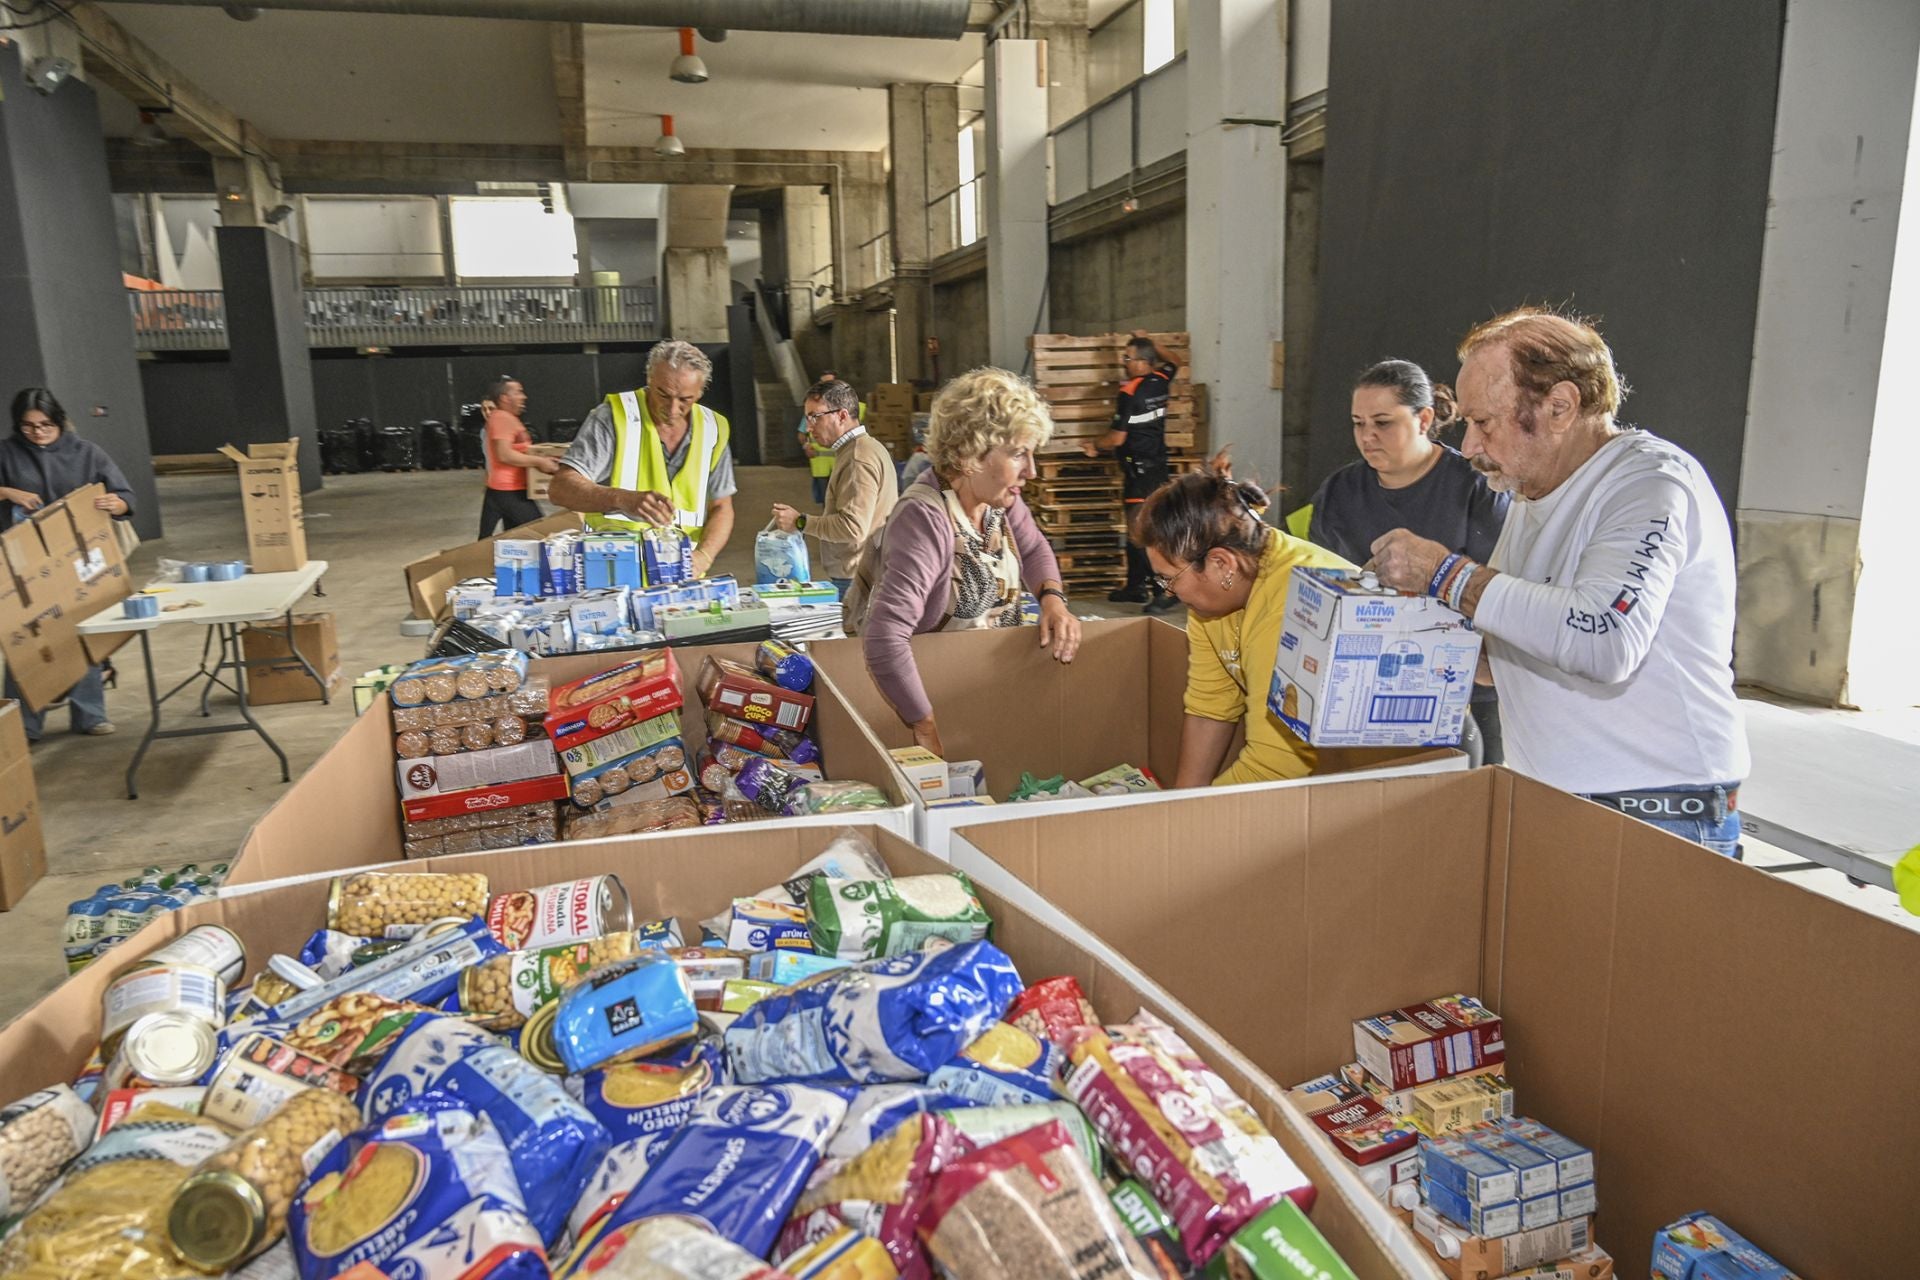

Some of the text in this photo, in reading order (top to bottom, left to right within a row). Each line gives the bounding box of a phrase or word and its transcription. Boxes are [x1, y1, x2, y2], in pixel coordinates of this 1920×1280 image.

[573, 553, 585, 593] entera
[681, 547, 693, 580] ntera
[1355, 605, 1396, 617] NATIVA
[743, 703, 773, 717] CHOCO
[745, 712, 767, 722] CUPS
[1619, 797, 1705, 815] POLO
[488, 894, 509, 945] FAMILIA
[556, 886, 570, 929] Fabada
[781, 928, 803, 939] ATÚN
[627, 1098, 696, 1125] ABELLÍN
[643, 1111, 689, 1133] FIDEO
[1327, 1103, 1369, 1124] COCIDO
[682, 1137, 746, 1207] SPAGHETTI
[370, 1232, 407, 1267] FIDE
[1261, 1225, 1314, 1273] Frutos
